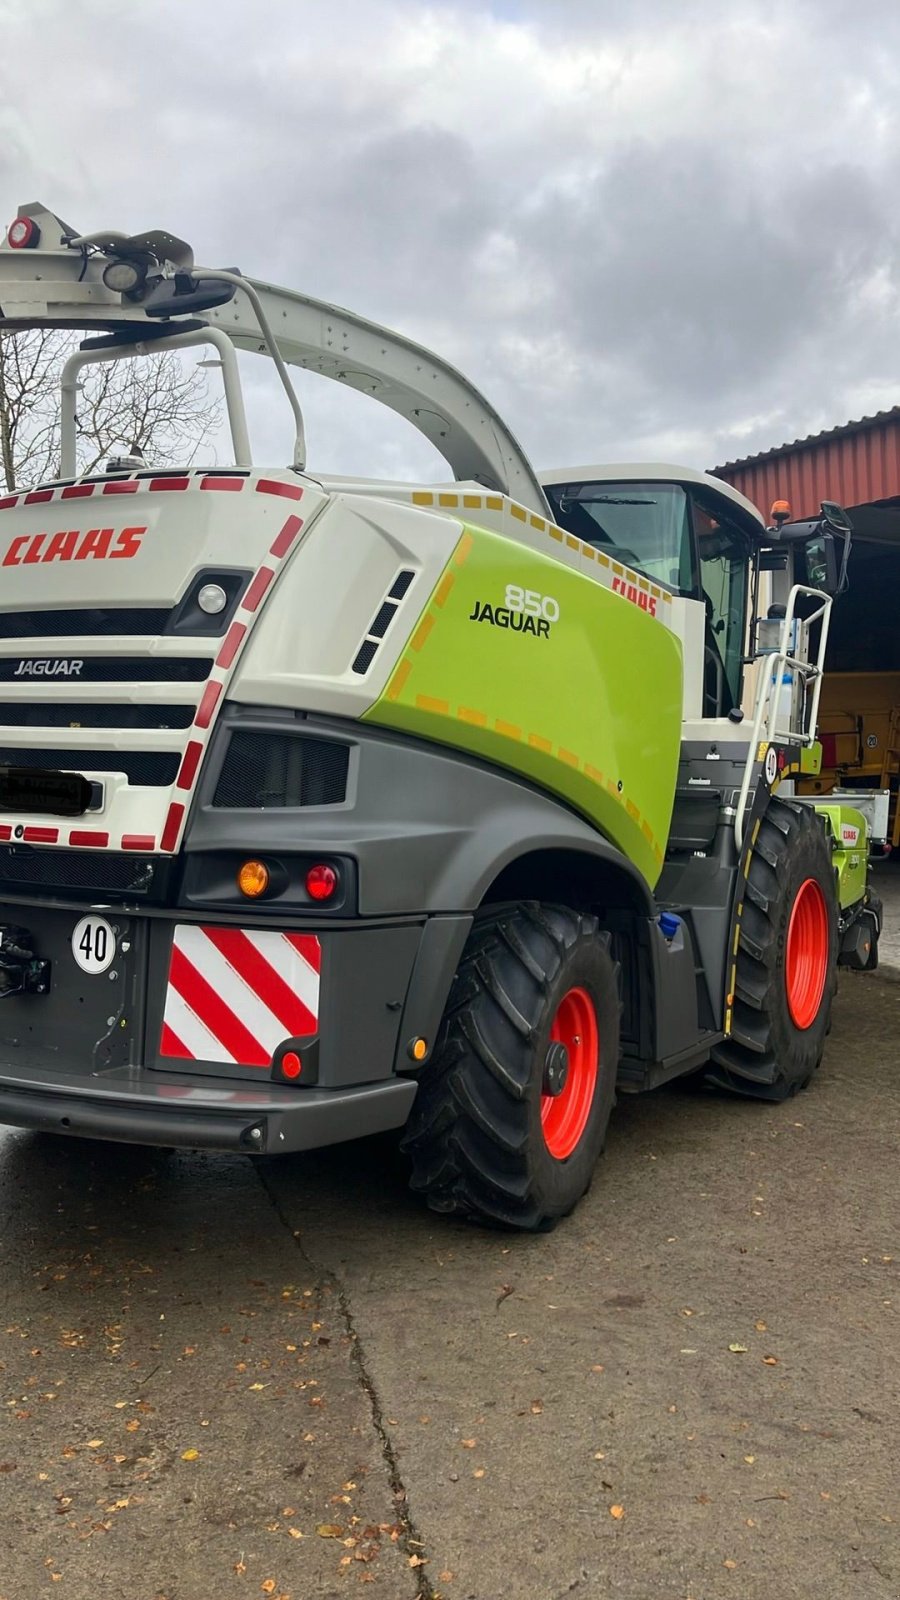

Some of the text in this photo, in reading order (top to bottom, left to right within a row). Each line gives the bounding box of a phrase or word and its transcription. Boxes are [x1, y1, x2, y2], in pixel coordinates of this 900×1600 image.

[2, 527, 148, 567] CLAAS
[469, 601, 550, 640] JAGUAR
[505, 584, 560, 622] 850
[14, 659, 84, 675] JAGUAR
[767, 753, 775, 776] 40
[843, 830, 856, 840] CLAAS
[79, 923, 107, 962] 40
